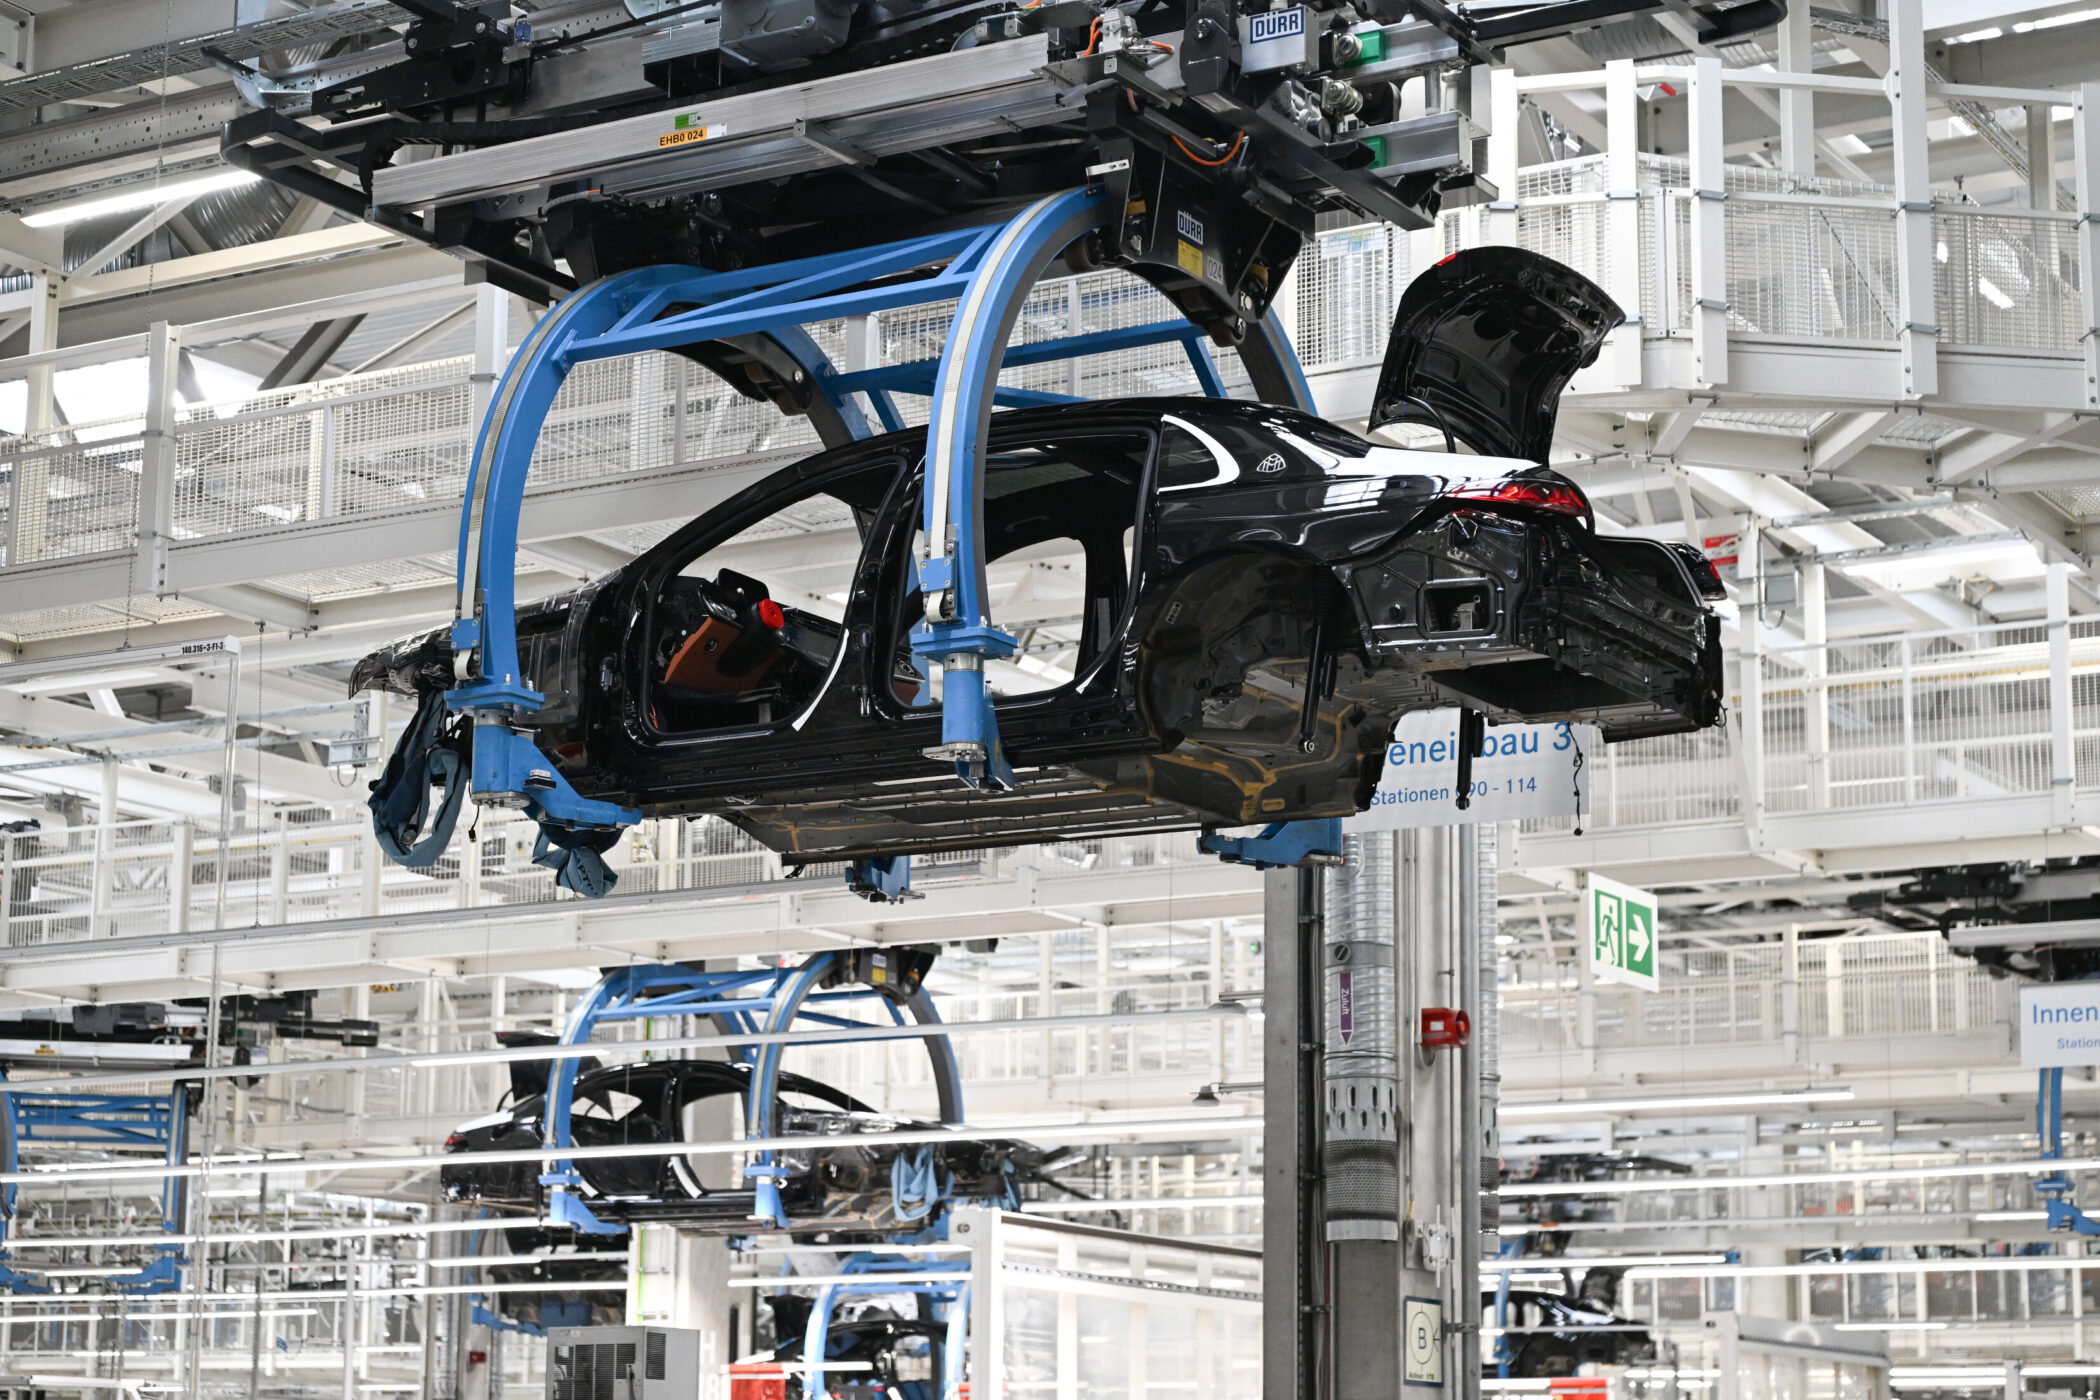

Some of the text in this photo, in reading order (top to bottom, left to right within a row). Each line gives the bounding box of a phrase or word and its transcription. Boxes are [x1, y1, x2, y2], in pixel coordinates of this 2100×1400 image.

[1255, 11, 1299, 38] DÜRR
[687, 129, 704, 141] 024
[1179, 211, 1202, 241] DÜRR
[1208, 259, 1222, 280] 024
[1388, 721, 1571, 767] eneibau 3
[1370, 786, 1449, 806] Stationen
[1456, 781, 1487, 798] 90
[1507, 777, 1537, 794] 114
[1341, 987, 1350, 1016] Zuluft
[2033, 1003, 2099, 1025] Innen
[1418, 1327, 1427, 1350] B
